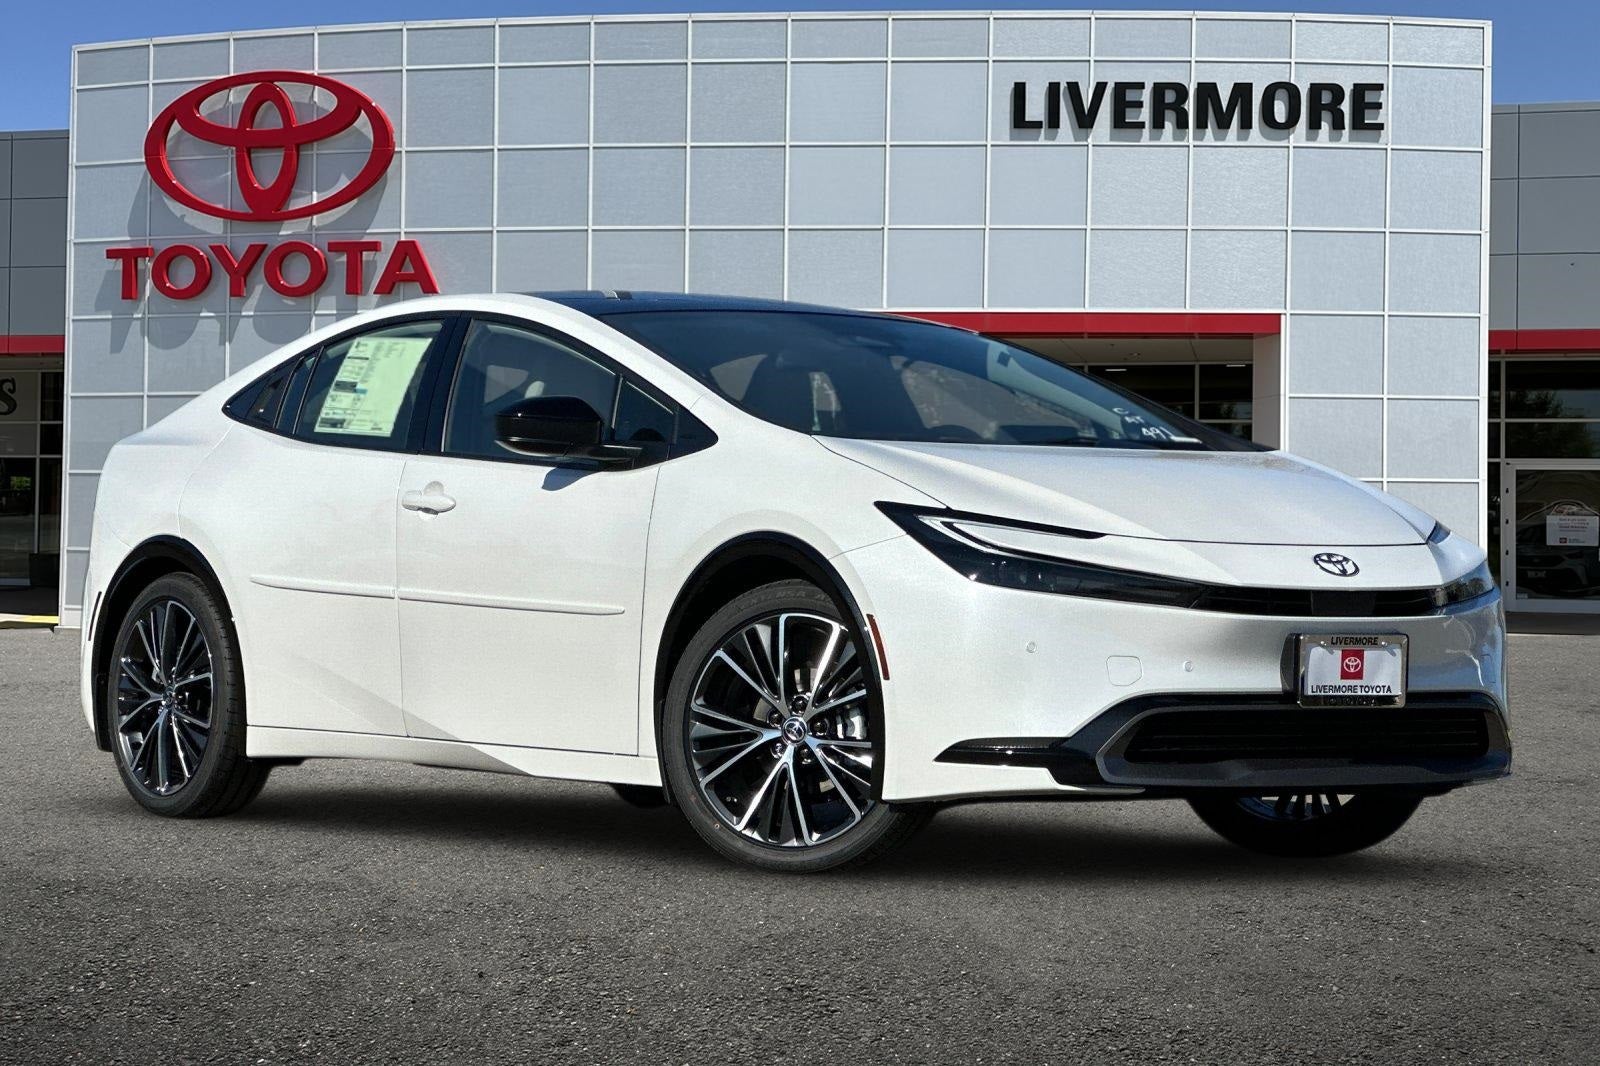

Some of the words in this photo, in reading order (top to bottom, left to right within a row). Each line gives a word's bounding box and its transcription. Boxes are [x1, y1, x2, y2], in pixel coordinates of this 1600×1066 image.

[1011, 81, 1385, 132] LIVERMORE
[105, 240, 441, 300] TOYOTA
[1330, 636, 1379, 646] LIVERMORE
[1311, 684, 1358, 694] LIVERMORE
[1360, 684, 1392, 694] TOYOTA
